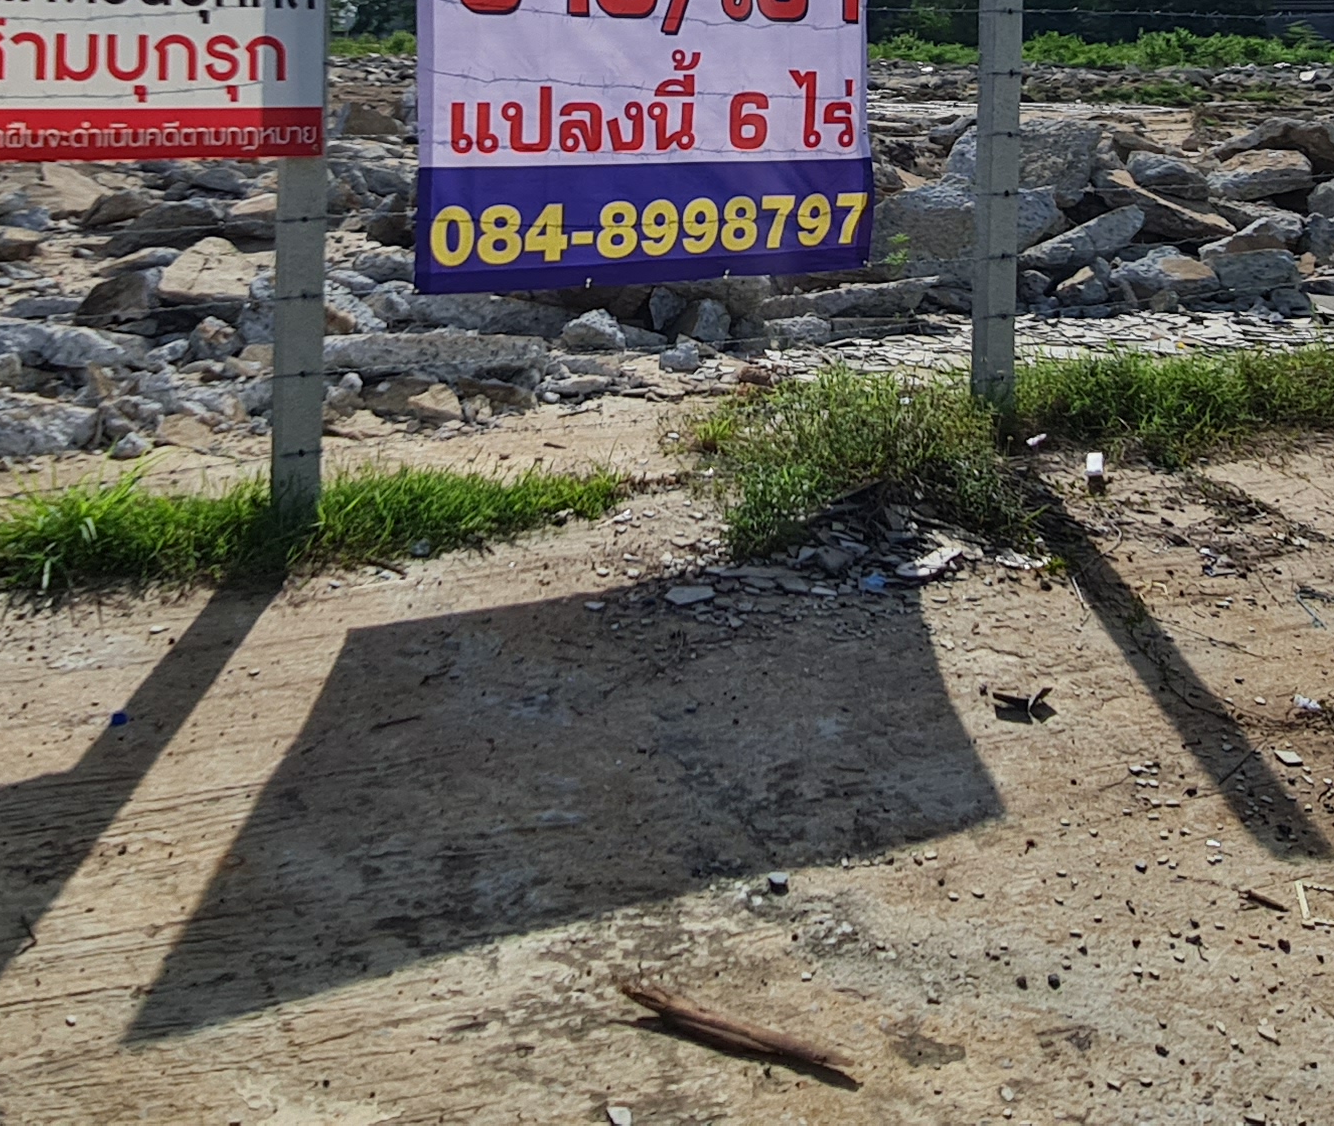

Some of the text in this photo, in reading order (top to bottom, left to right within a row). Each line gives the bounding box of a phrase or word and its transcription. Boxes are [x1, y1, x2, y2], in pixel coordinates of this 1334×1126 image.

[450, 49, 856, 155] แปลงนี้ 6 ไร่
[429, 191, 868, 268] 084-8998797
